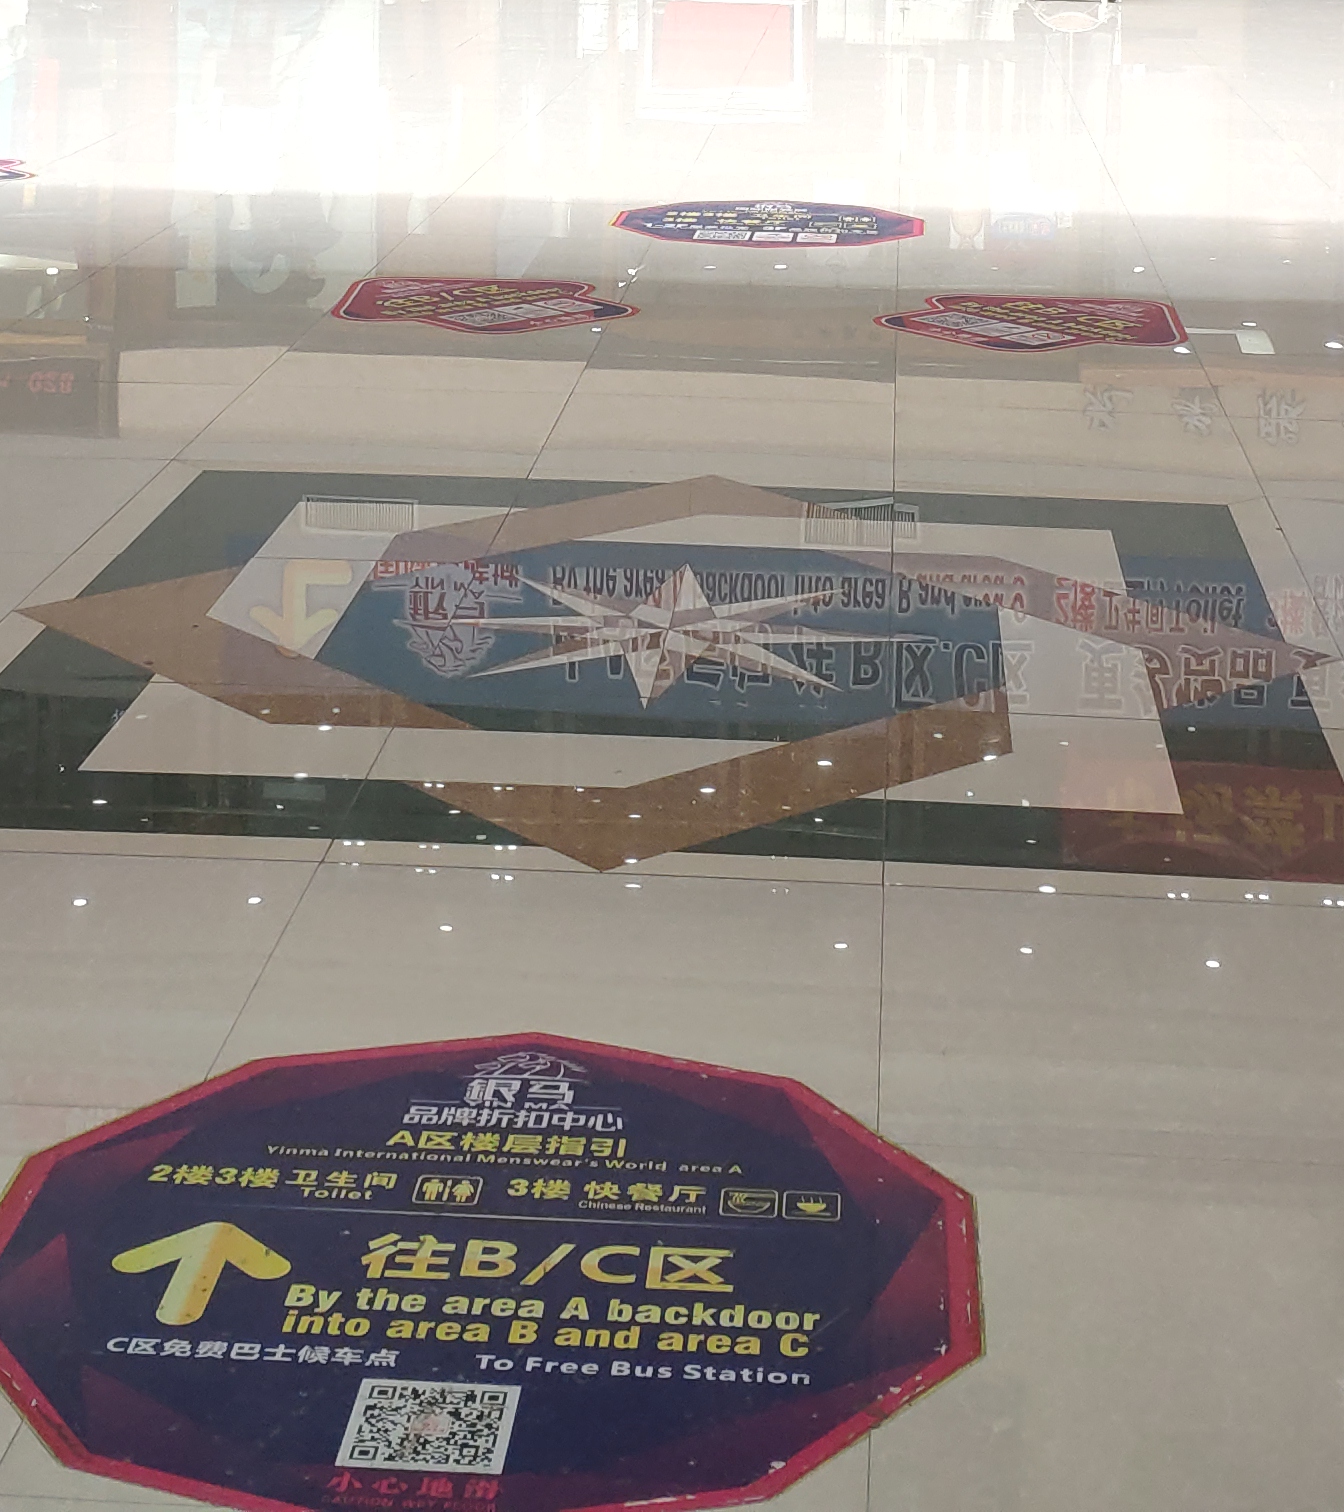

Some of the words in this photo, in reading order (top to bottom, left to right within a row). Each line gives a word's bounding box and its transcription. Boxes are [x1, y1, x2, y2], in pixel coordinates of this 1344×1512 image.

[402, 1104, 625, 1132] 品牌折扣中心
[267, 1144, 329, 1157] Yinma
[334, 1147, 470, 1163] International
[476, 1153, 599, 1169] Menswear's
[605, 1158, 667, 1172] World
[678, 1164, 723, 1173] area
[728, 1164, 744, 1174] A
[386, 1128, 627, 1158] A区楼层指引
[148, 1164, 281, 1189] 2楼3楼
[284, 1167, 398, 1191] 卫生间
[507, 1178, 571, 1201] 3楼
[583, 1180, 707, 1204] 快餐厅
[301, 1186, 373, 1201] Toilet
[578, 1199, 632, 1211] Chinese
[360, 1232, 735, 1292] 往B/C区
[283, 1284, 342, 1312] By
[356, 1288, 432, 1314] the
[442, 1295, 545, 1319] area
[559, 1296, 590, 1321] A
[607, 1298, 821, 1331] backdoor
[281, 1310, 371, 1337] into
[386, 1319, 490, 1343] area
[507, 1319, 539, 1345] B
[554, 1325, 640, 1350] and
[657, 1331, 761, 1356] area
[778, 1332, 810, 1357] C
[105, 1336, 400, 1368] C区免费巴士候车点
[474, 1354, 513, 1372] To
[525, 1356, 601, 1377] Free
[611, 1361, 672, 1379] Bus
[683, 1364, 812, 1385] Station
